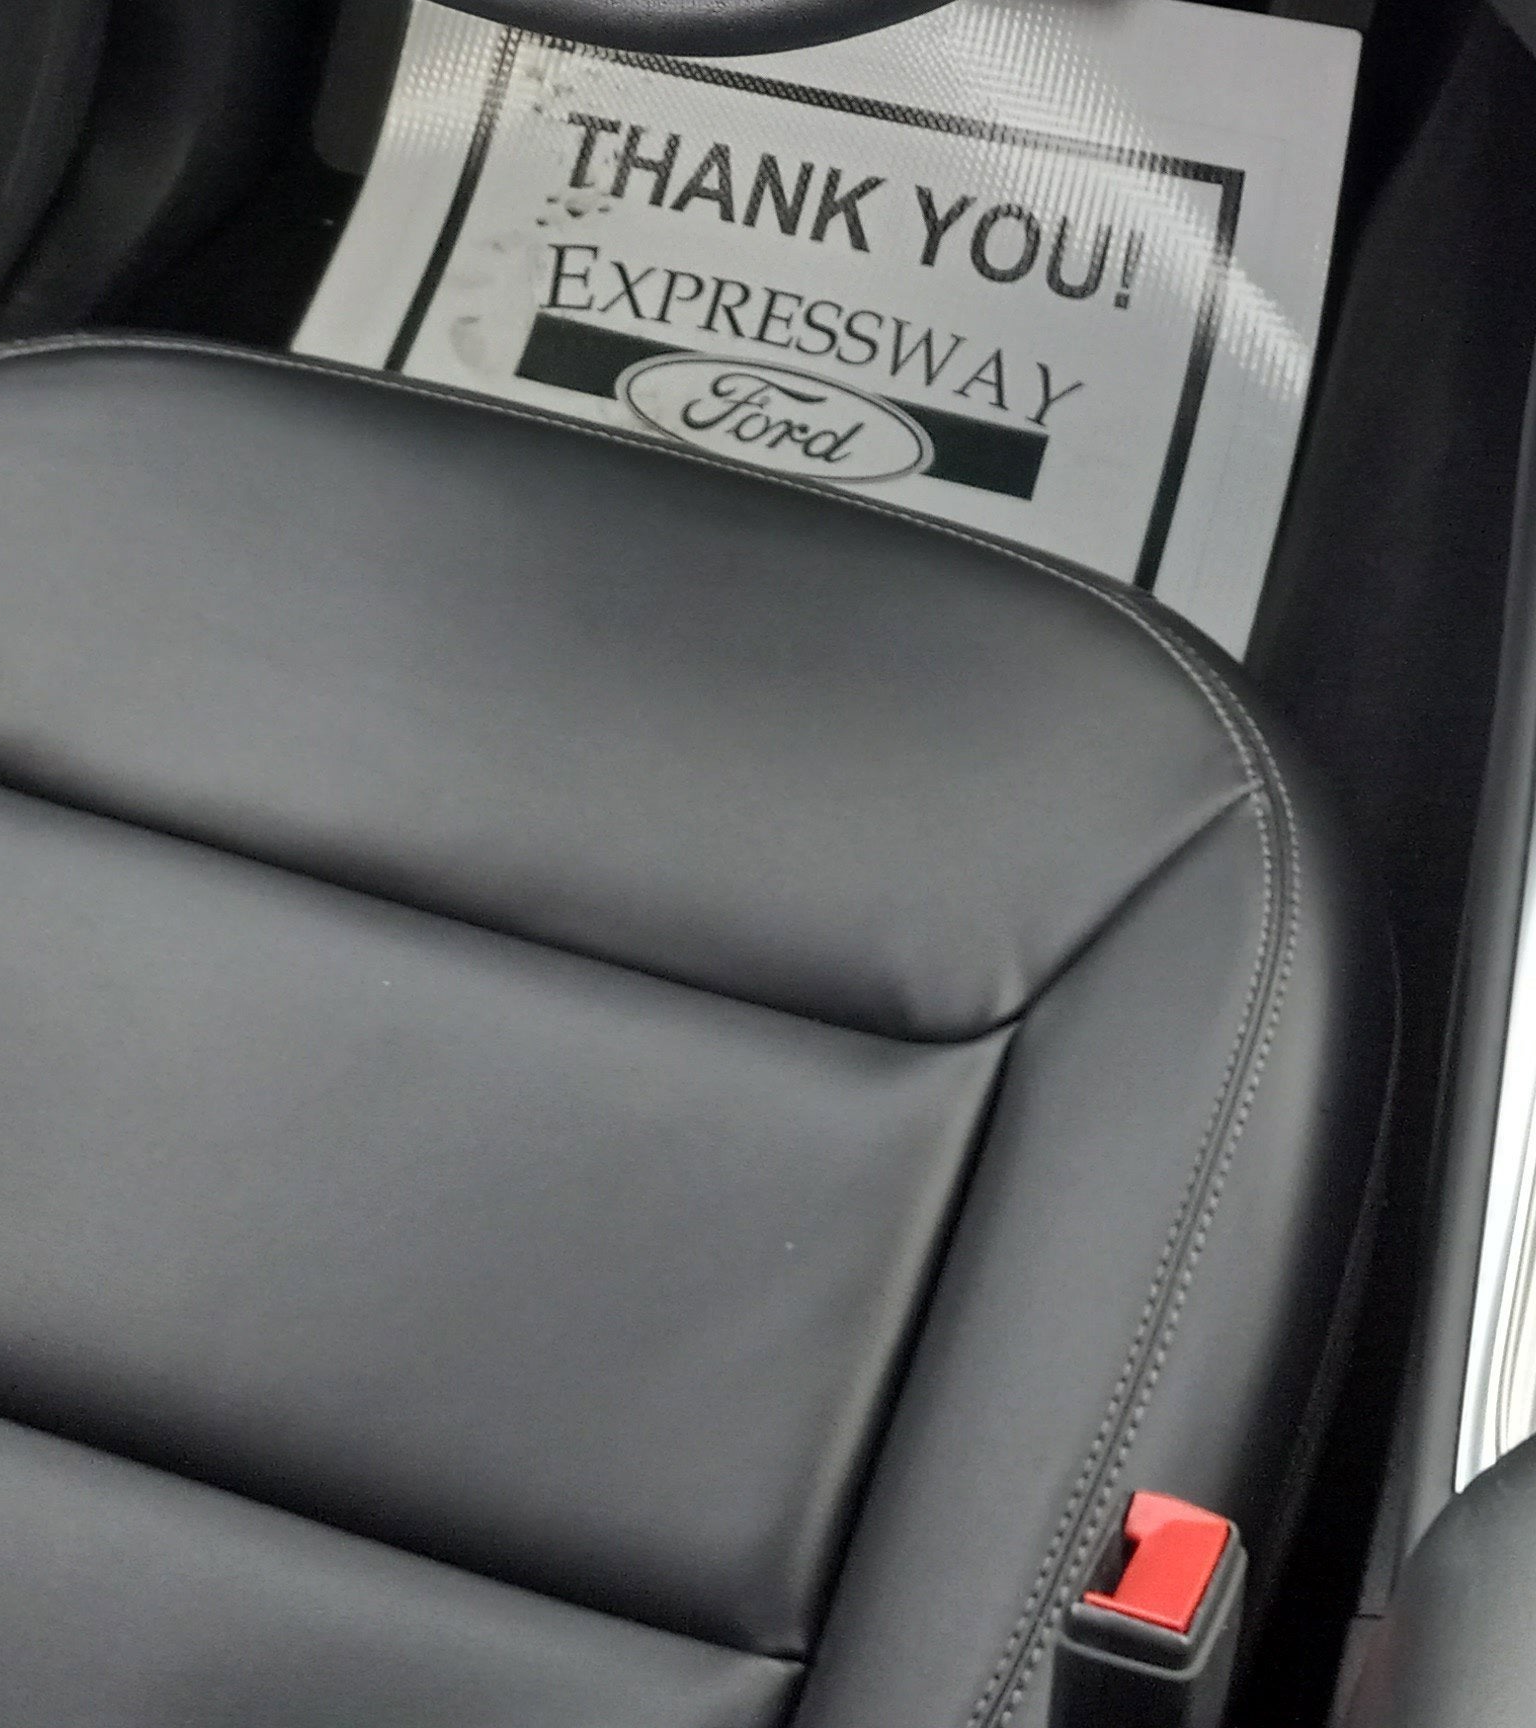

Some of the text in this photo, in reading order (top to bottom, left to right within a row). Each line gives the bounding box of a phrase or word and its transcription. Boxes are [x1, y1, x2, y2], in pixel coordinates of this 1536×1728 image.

[567, 112, 1143, 310] THANK YOU!
[544, 242, 1085, 428] EXPRESSWAY
[681, 372, 863, 464] Ford
